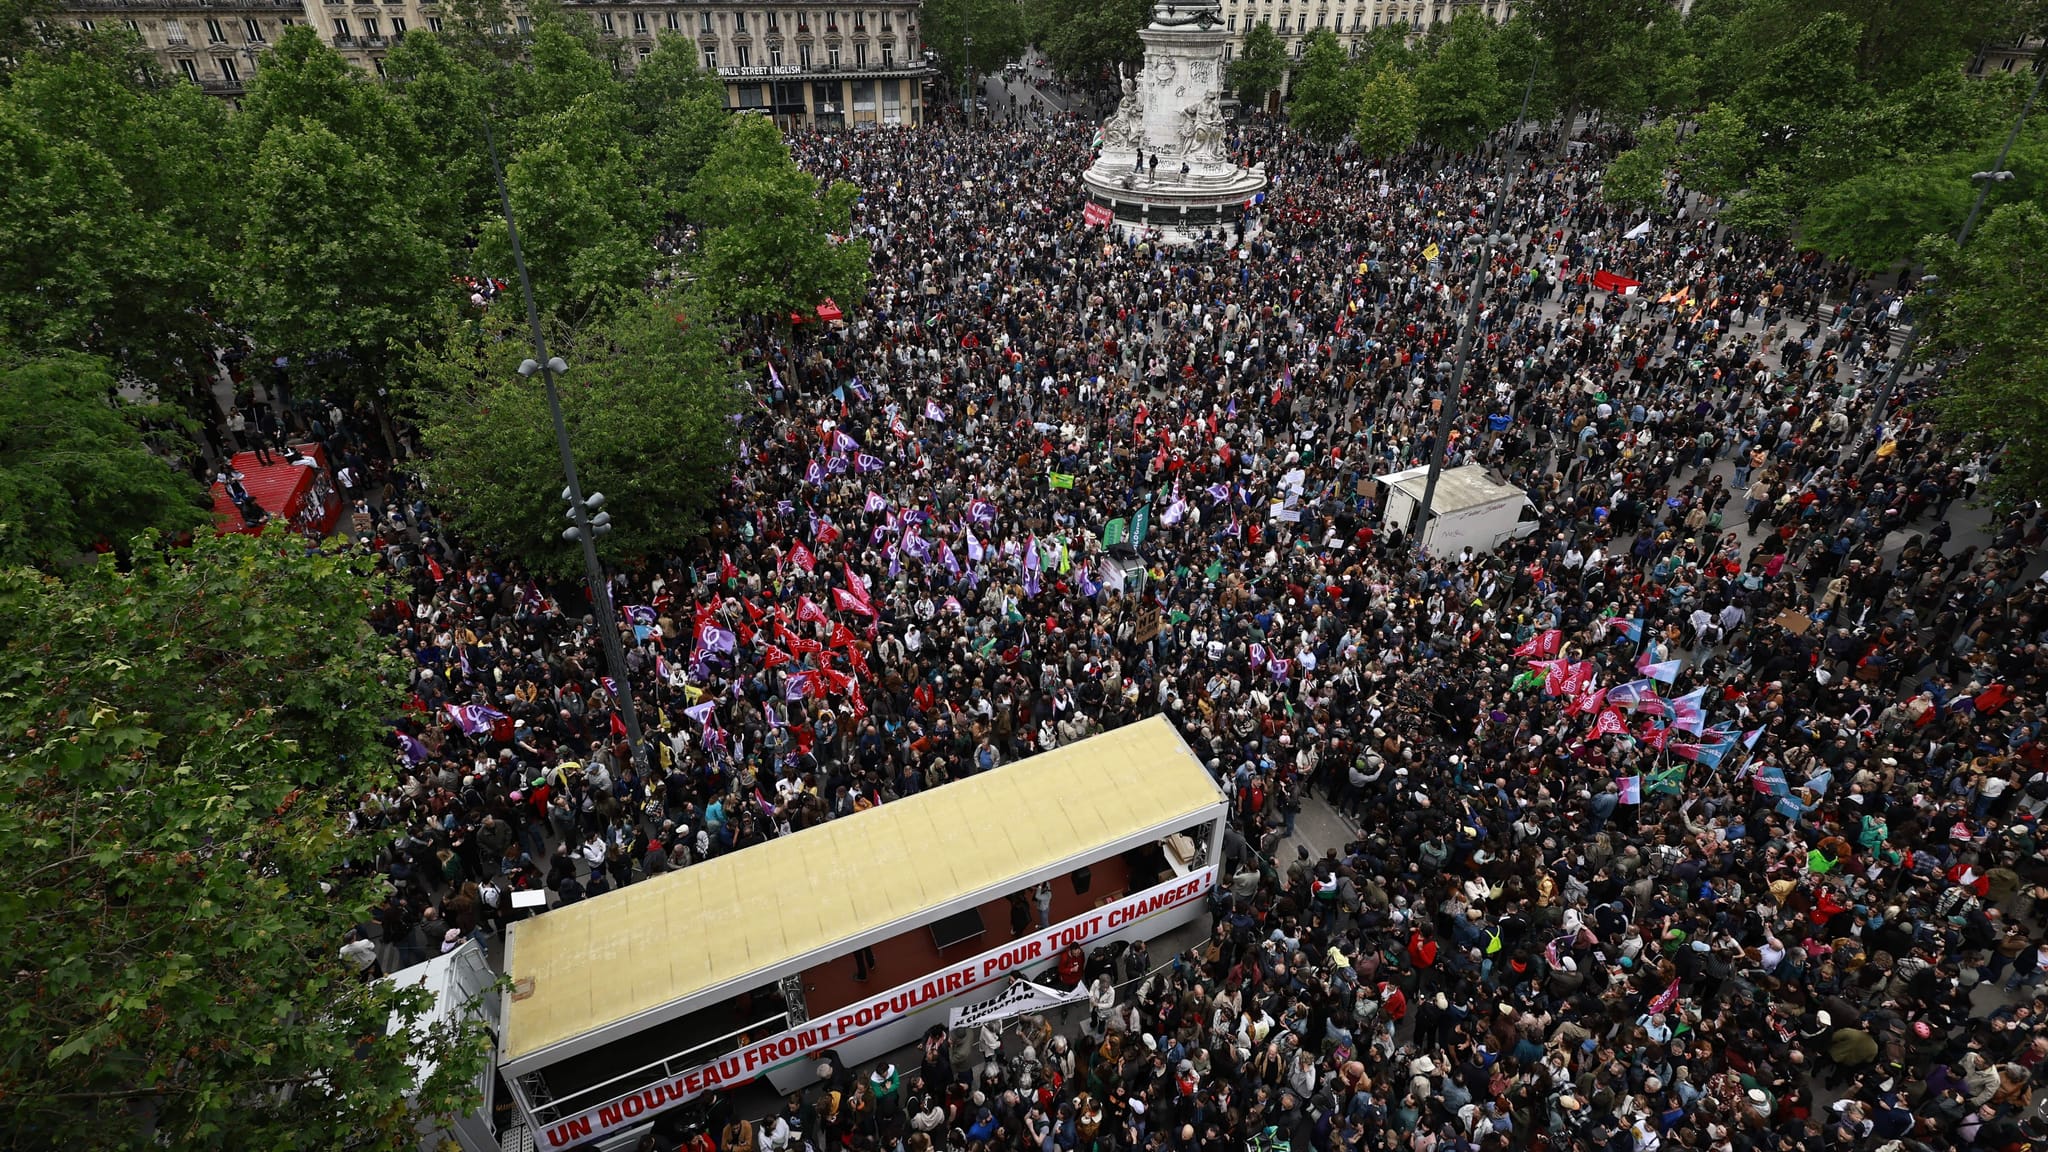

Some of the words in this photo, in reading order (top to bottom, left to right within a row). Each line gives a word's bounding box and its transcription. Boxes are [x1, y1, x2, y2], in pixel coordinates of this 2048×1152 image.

[717, 67, 739, 76] WALL
[741, 66, 768, 76] STREET
[546, 1116, 592, 1148] UN
[597, 1056, 741, 1129] NOUVEAU
[743, 1022, 832, 1072] FRONT
[837, 966, 976, 1035] POPULAIRE
[983, 940, 1042, 977] POUR
[1047, 916, 1103, 951] TOUT
[1107, 878, 1201, 928] CHANGER
[1204, 871, 1212, 888] !
